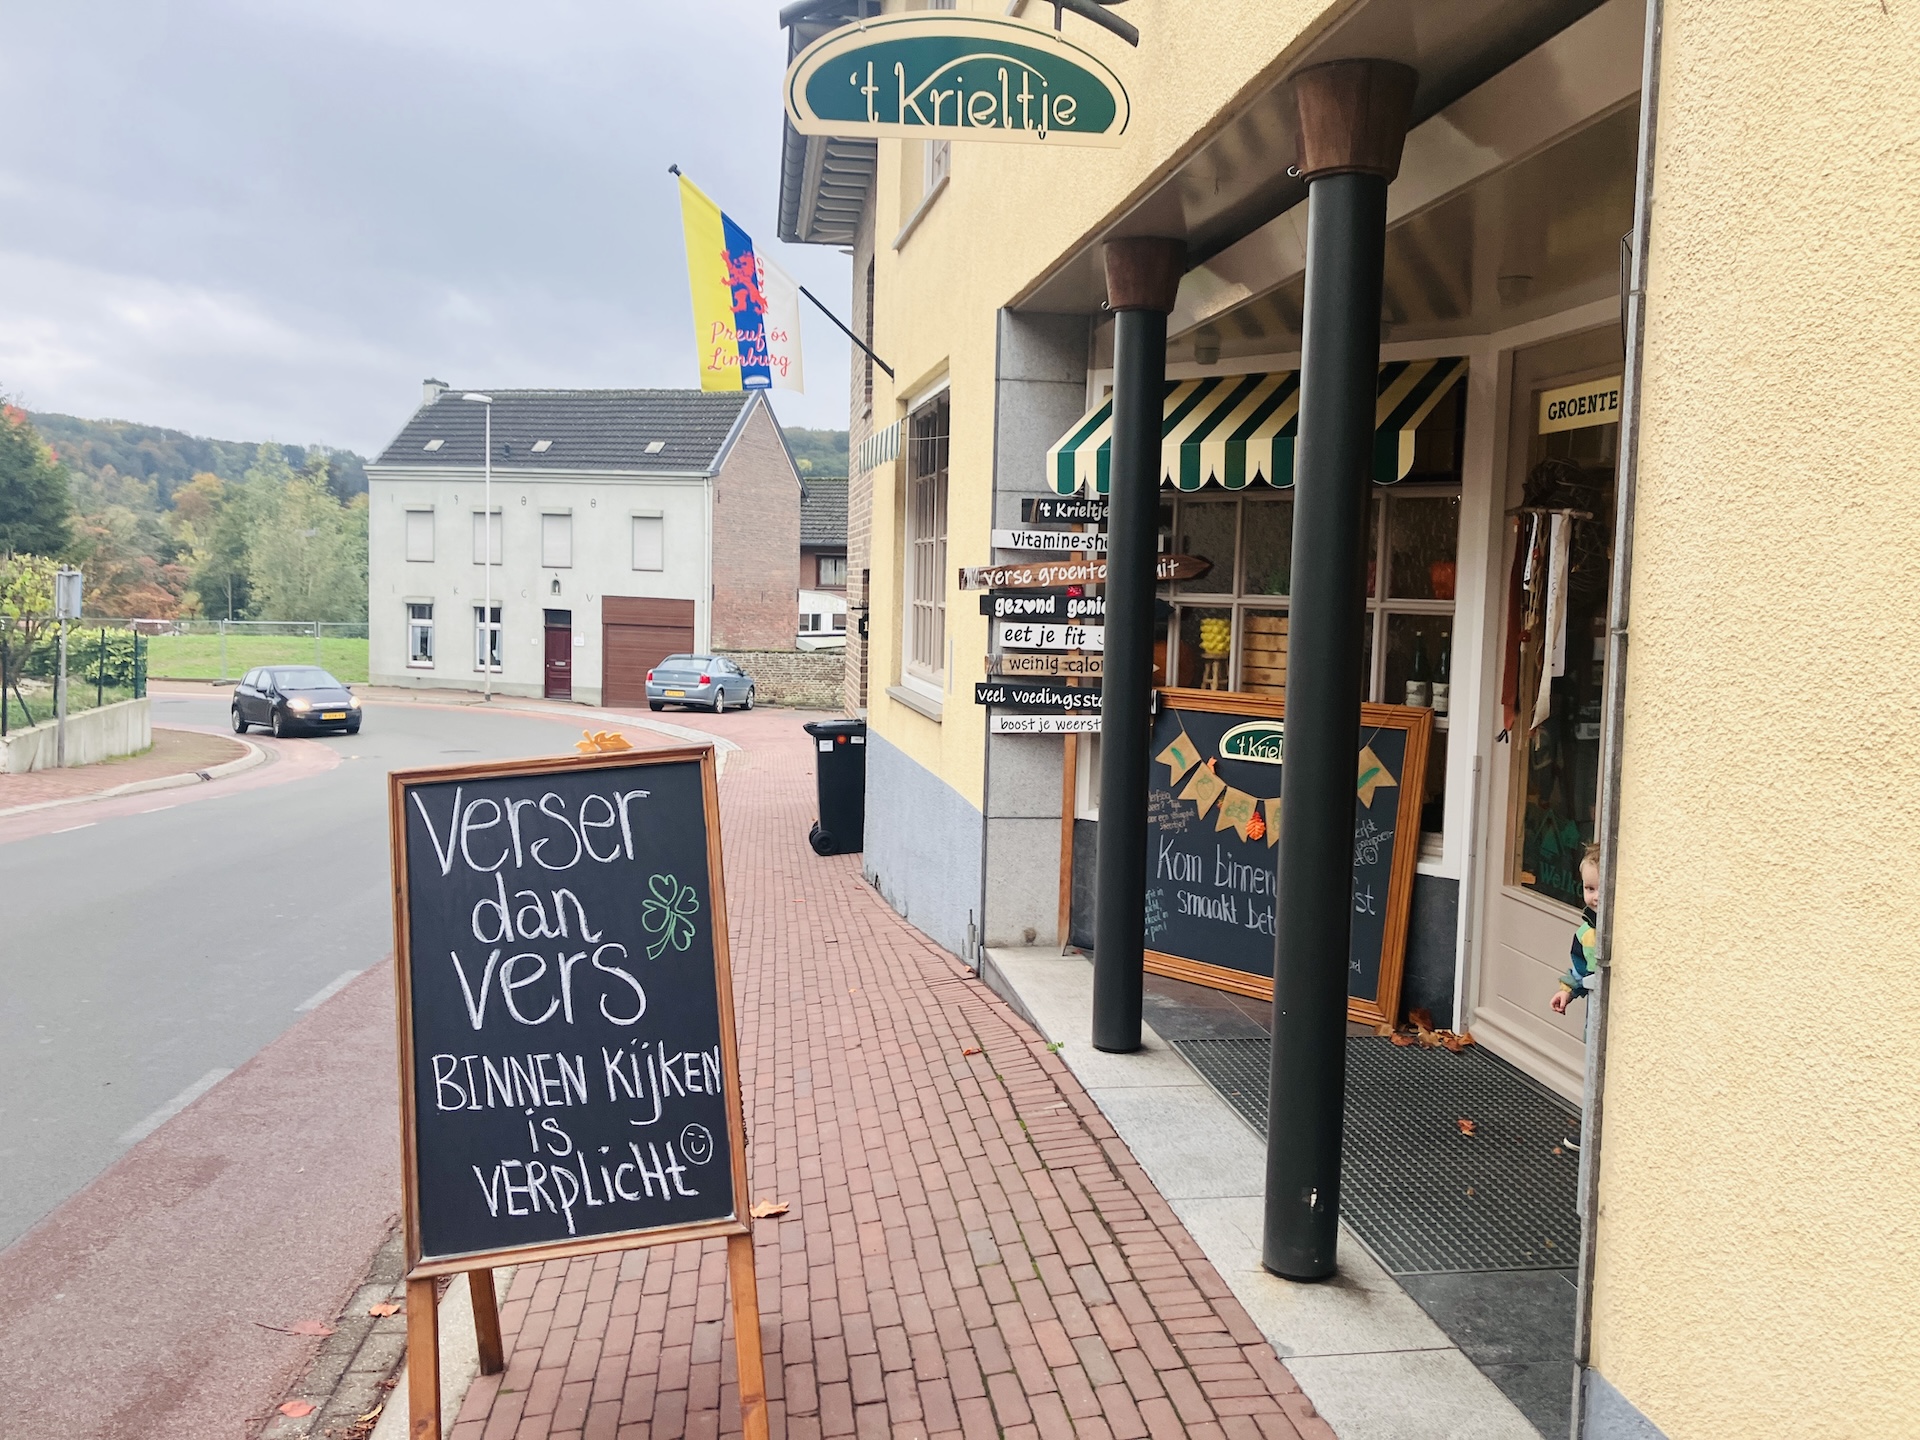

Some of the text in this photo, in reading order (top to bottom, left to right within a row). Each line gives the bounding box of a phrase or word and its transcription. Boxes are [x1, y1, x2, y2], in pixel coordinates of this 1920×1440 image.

[894, 53, 1077, 140] Krieltje
[711, 321, 766, 352] Preuf
[707, 347, 792, 377] Limburg
[1548, 390, 1618, 420] GROENTE
[1055, 501, 1109, 521] Krieltje
[984, 568, 1032, 587] verse
[1004, 625, 1086, 647] eet je fit
[1009, 656, 1059, 675] weinig
[977, 687, 1006, 703] veel
[1000, 718, 1035, 731] boost
[1038, 718, 1051, 733] je
[411, 786, 650, 876] Verser
[1156, 834, 1202, 883] Kom
[471, 872, 603, 943] dan
[1177, 889, 1239, 925] smaakt
[1244, 898, 1278, 937] bet
[432, 1053, 588, 1112] BINNEN
[525, 1107, 574, 1157] is
